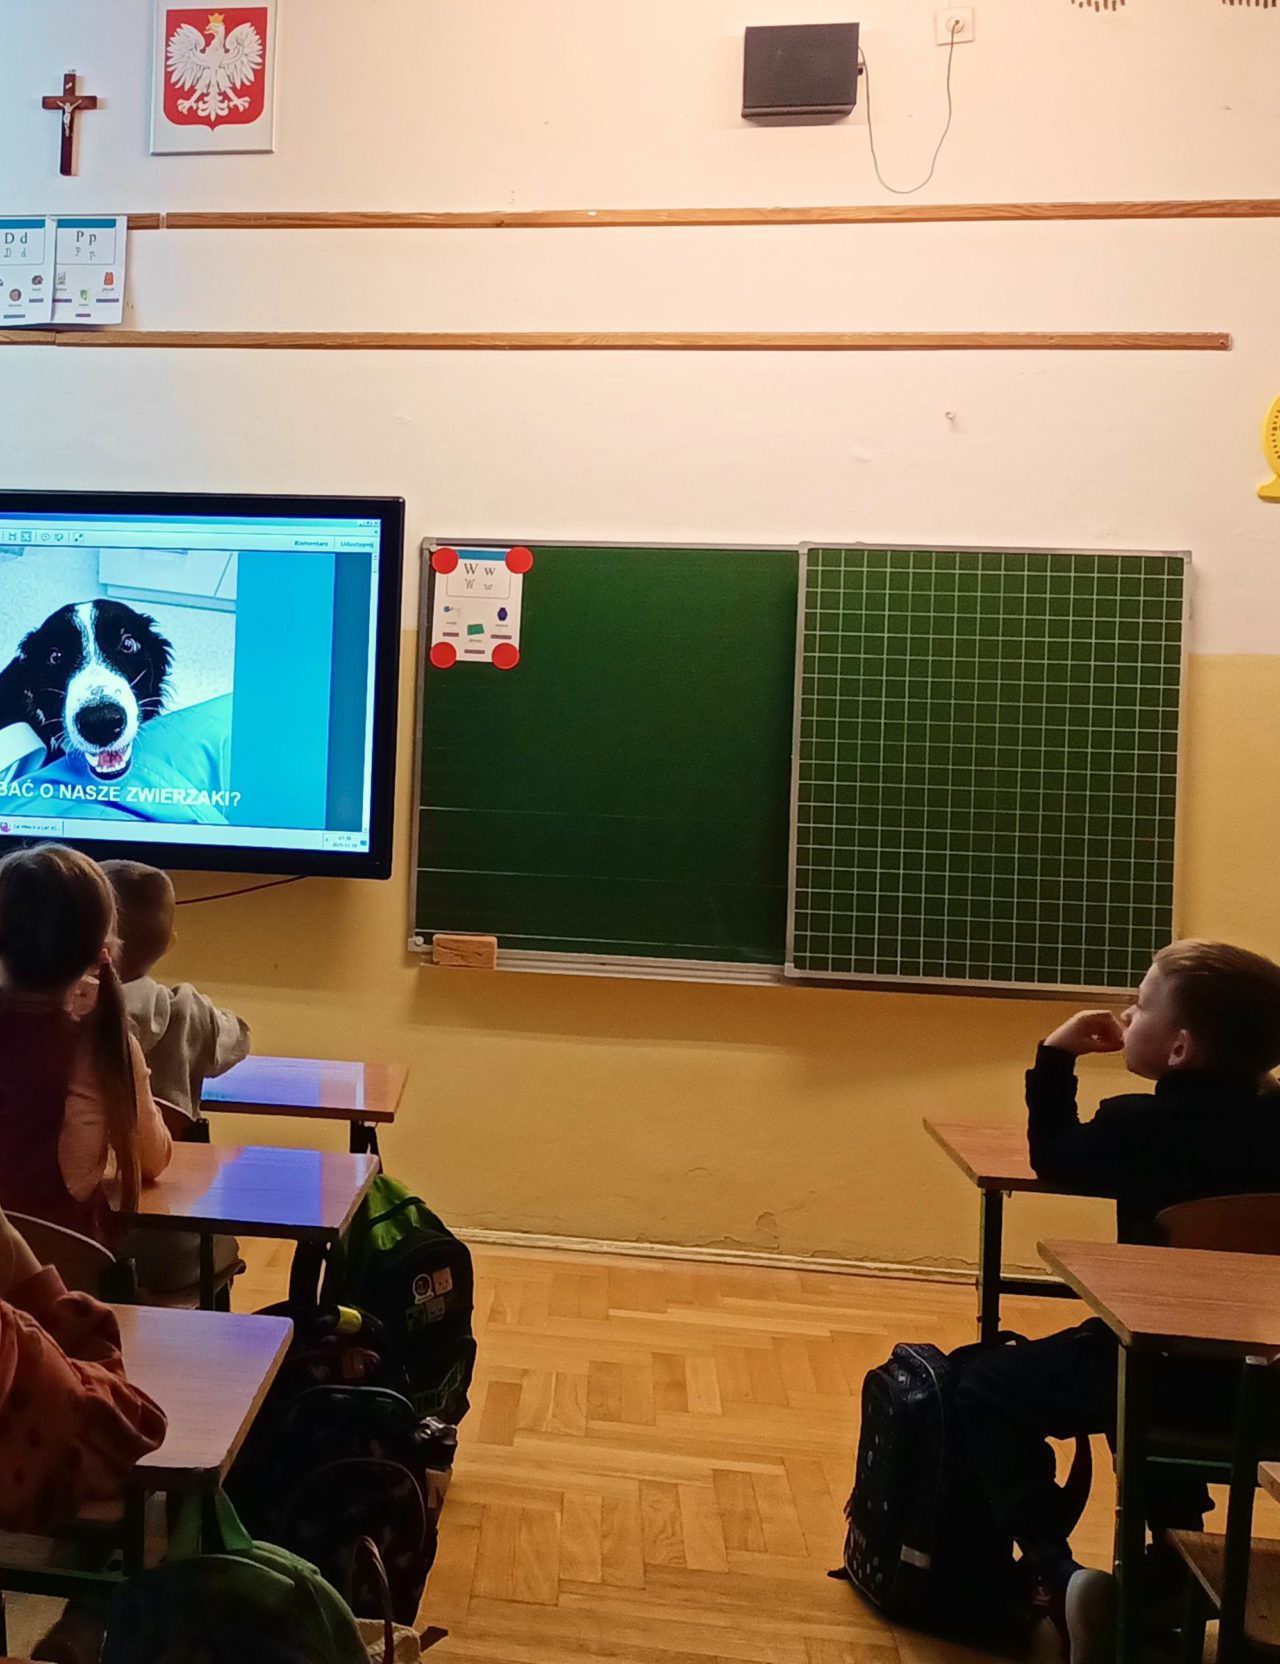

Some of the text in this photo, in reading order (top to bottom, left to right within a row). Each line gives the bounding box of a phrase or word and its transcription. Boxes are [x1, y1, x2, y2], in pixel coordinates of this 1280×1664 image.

[4, 232, 28, 244] D d
[75, 231, 97, 246] P p
[464, 563, 496, 576] W w
[39, 783, 54, 799] O
[59, 784, 120, 801] NASZE
[126, 786, 241, 807] ZWIERZAKI?
